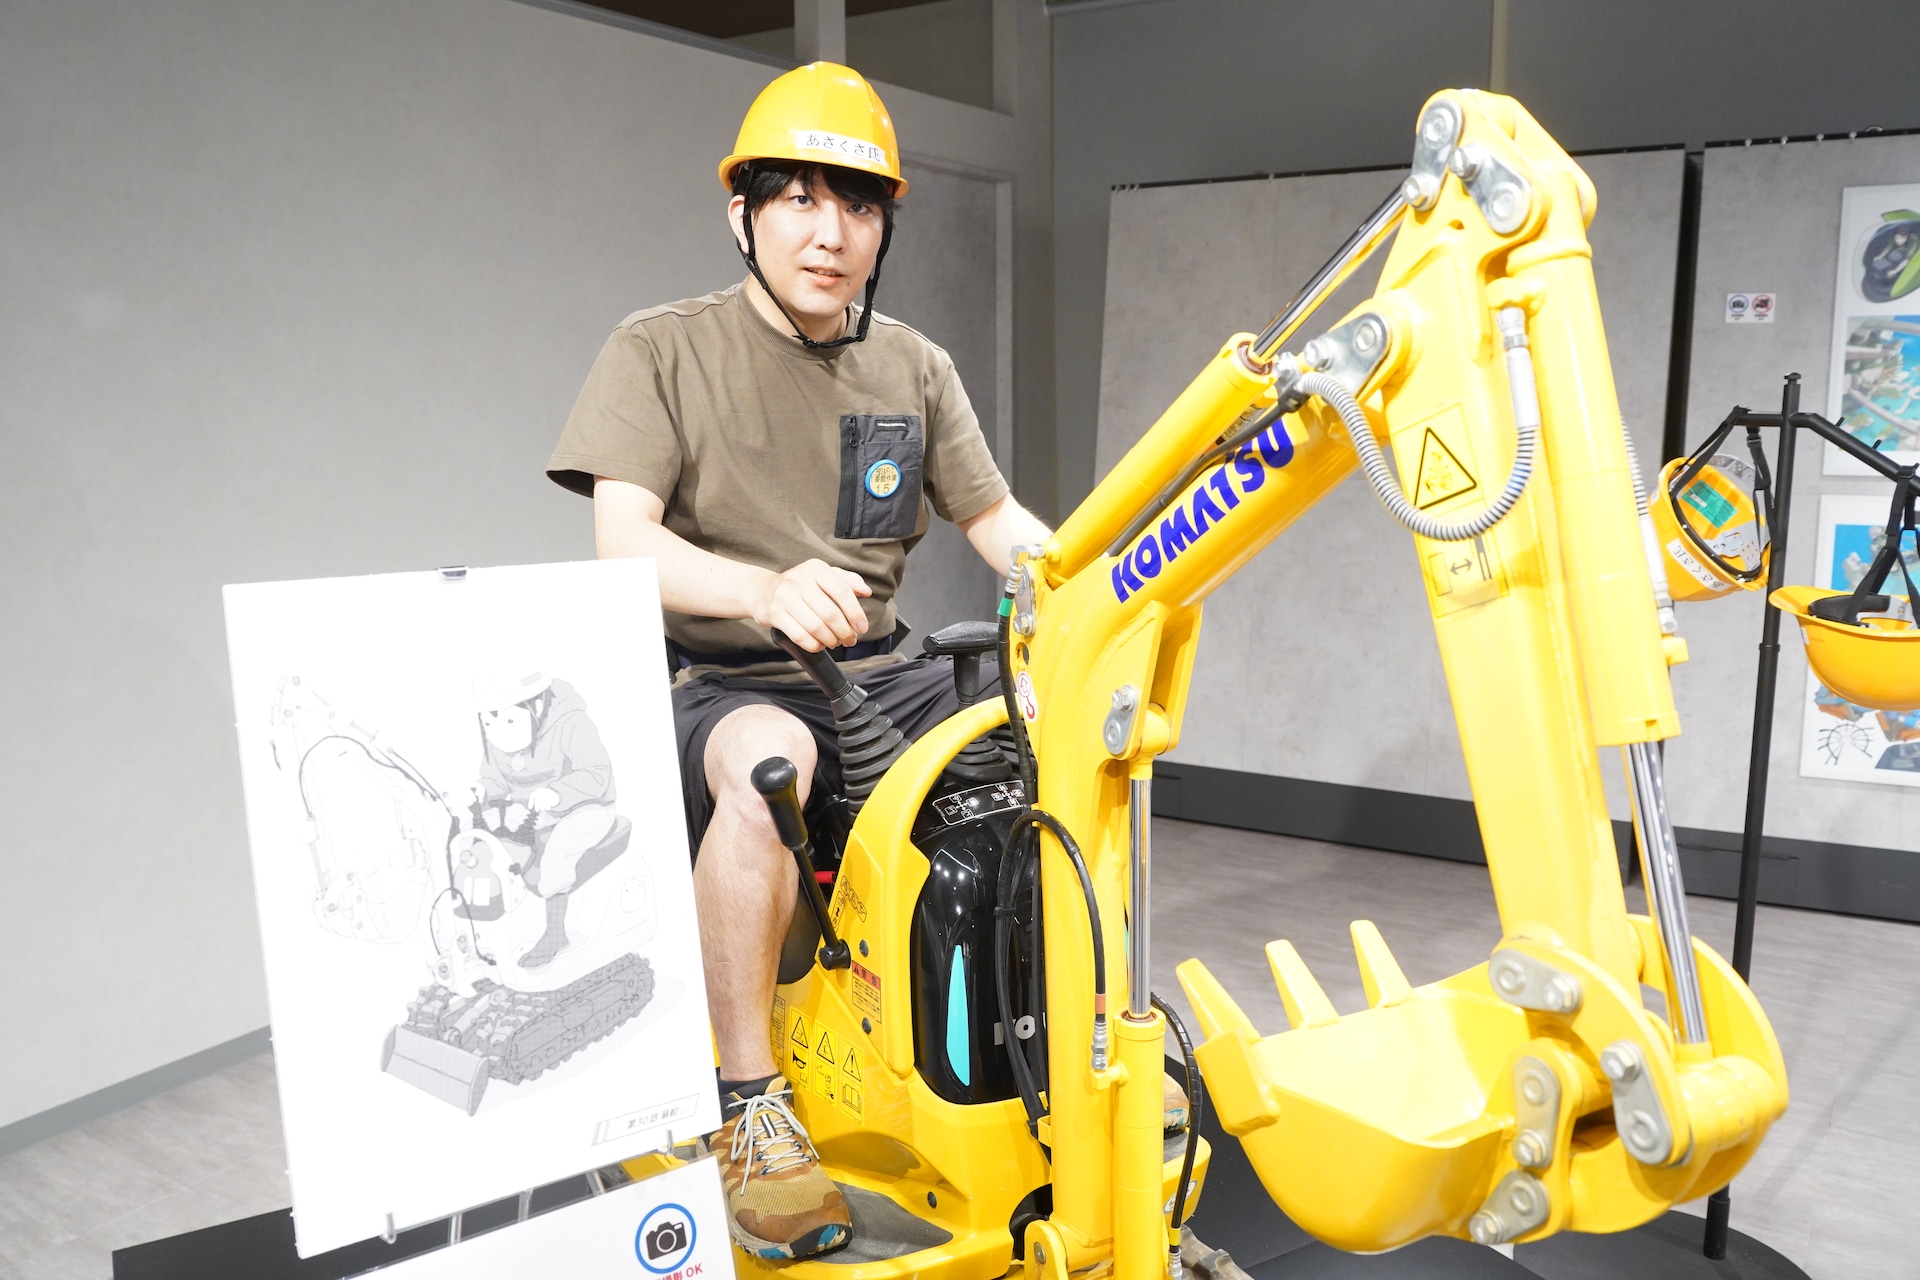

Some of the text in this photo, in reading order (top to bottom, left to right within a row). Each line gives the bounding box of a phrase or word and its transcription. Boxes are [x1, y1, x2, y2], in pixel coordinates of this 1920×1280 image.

[806, 133, 881, 162] あさくさ氏
[876, 483, 890, 495] 15
[1111, 417, 1295, 604] KOMATSU
[686, 1262, 703, 1278] OK
